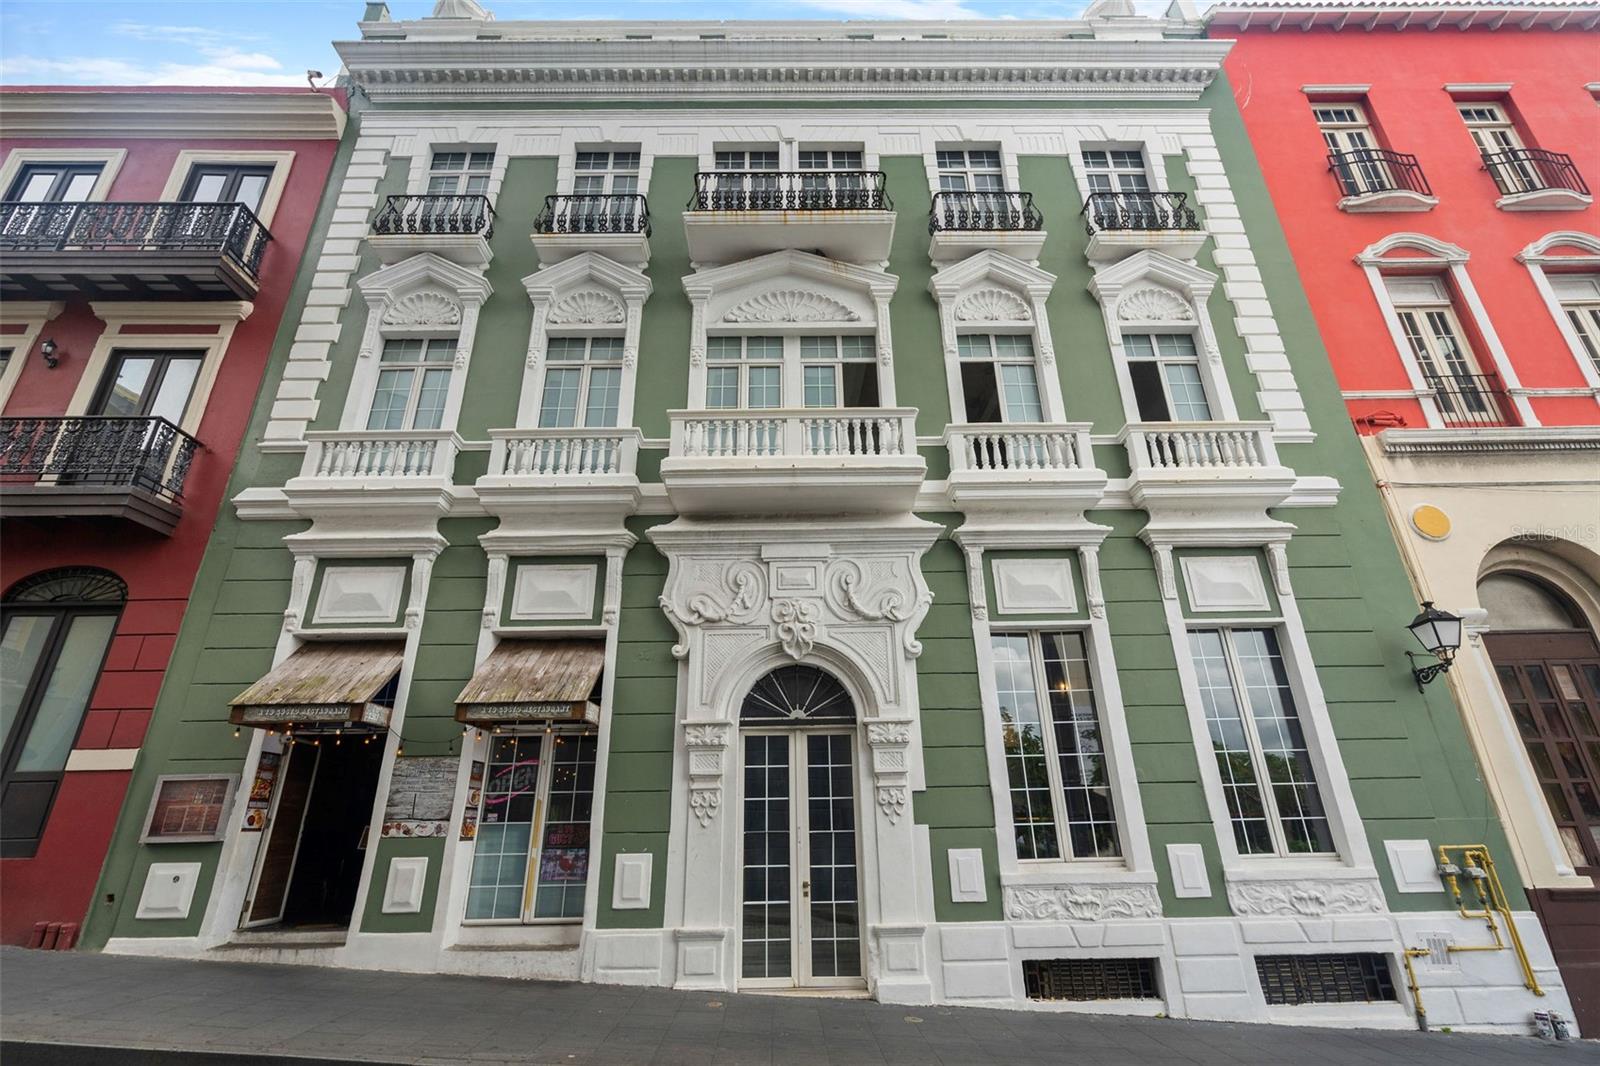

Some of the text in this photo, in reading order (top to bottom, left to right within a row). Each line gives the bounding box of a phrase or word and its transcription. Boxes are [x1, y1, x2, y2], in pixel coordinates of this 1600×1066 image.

[300, 707, 348, 715] RESTAURANT
[522, 705, 570, 713] RESTAURANT
[488, 767, 536, 798] OPEN
